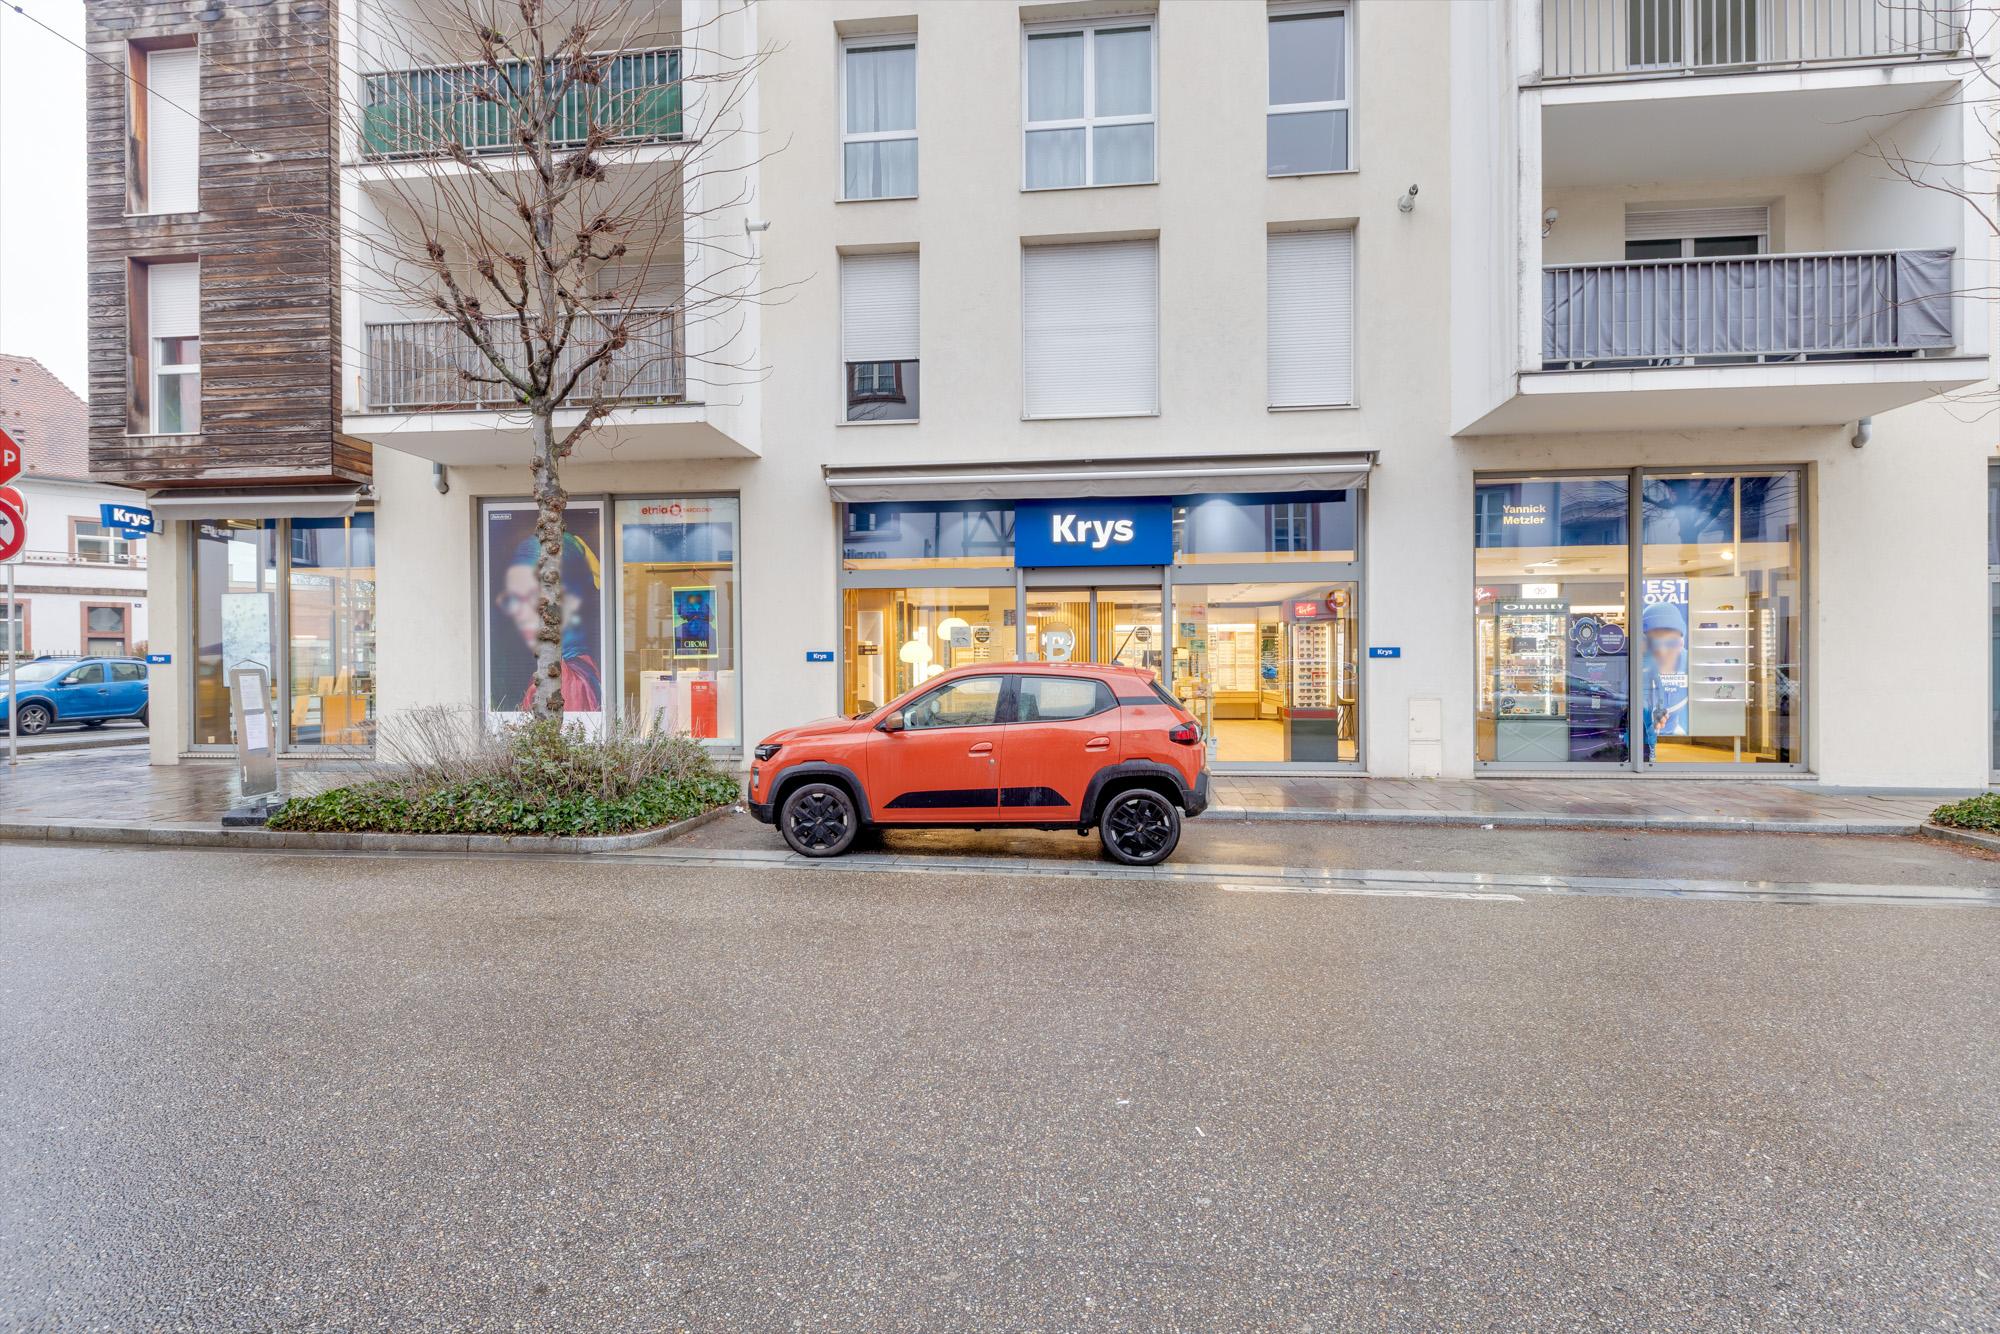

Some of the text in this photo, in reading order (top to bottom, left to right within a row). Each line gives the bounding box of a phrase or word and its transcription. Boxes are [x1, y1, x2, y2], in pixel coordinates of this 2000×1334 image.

[641, 506, 668, 515] etnia
[1503, 505, 1546, 513] Yannick
[113, 508, 151, 526] Krys
[1503, 516, 1545, 525] Metzler
[1053, 514, 1134, 549] Krys
[1643, 593, 1688, 604] OYAL
[684, 640, 708, 648] CHROMA
